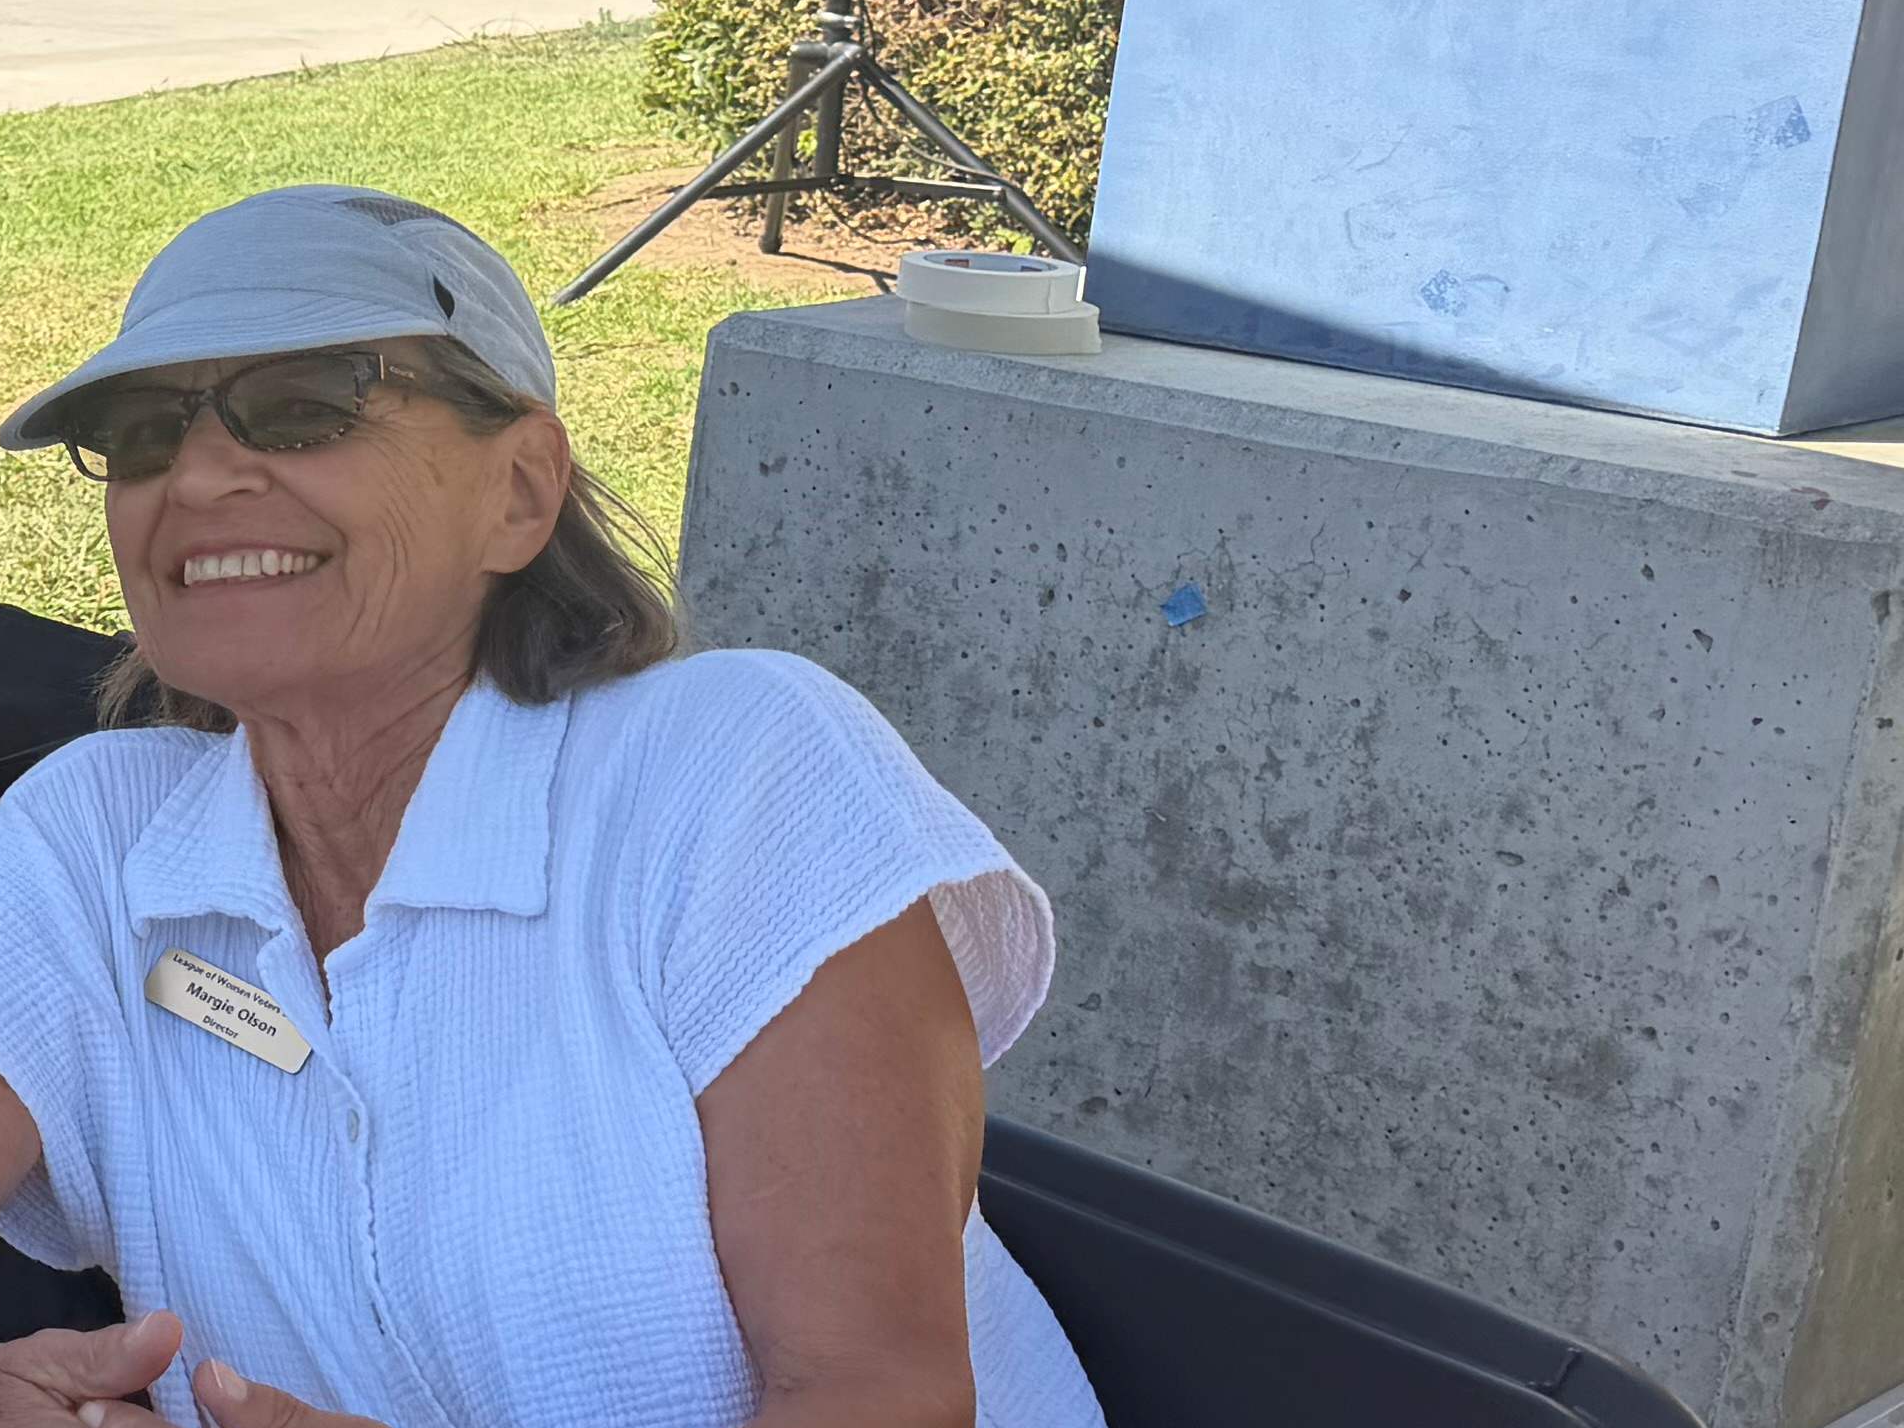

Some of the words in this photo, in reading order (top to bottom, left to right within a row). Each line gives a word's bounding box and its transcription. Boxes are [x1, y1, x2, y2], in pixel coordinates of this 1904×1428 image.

[172, 953, 205, 974] League
[205, 971, 216, 980] of
[217, 974, 251, 999] Women
[253, 993, 281, 1014] Voters
[185, 982, 235, 1015] Margie
[237, 1008, 277, 1037] Olson
[202, 1015, 239, 1039] Director
